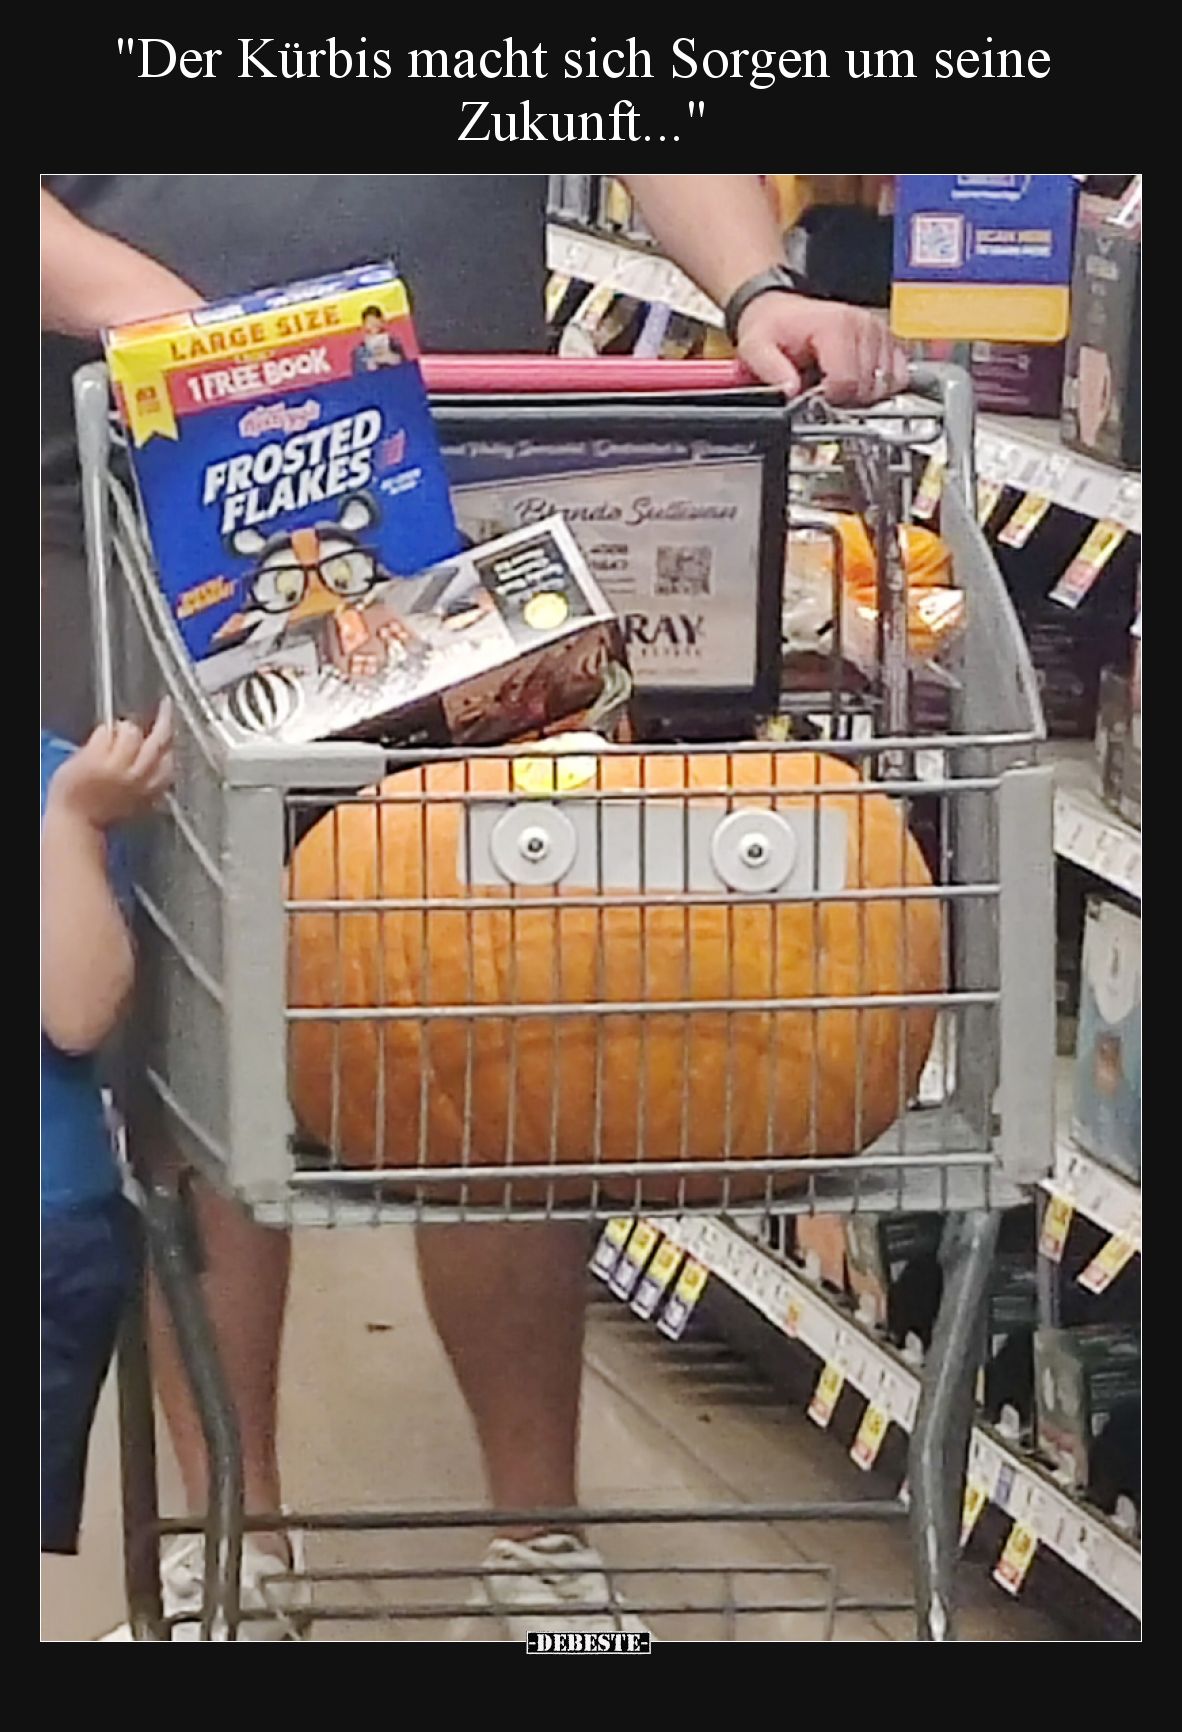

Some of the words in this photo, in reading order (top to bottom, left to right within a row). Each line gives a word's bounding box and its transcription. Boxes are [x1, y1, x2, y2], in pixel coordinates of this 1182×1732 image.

[170, 322, 265, 361] LARGE
[276, 305, 341, 338] SIZE
[187, 376, 201, 403] 1
[202, 363, 264, 401] FREE
[264, 347, 332, 386] BOOK
[203, 408, 382, 505] FROSTED
[220, 448, 372, 535] FLAKES
[625, 612, 704, 644] RAY
